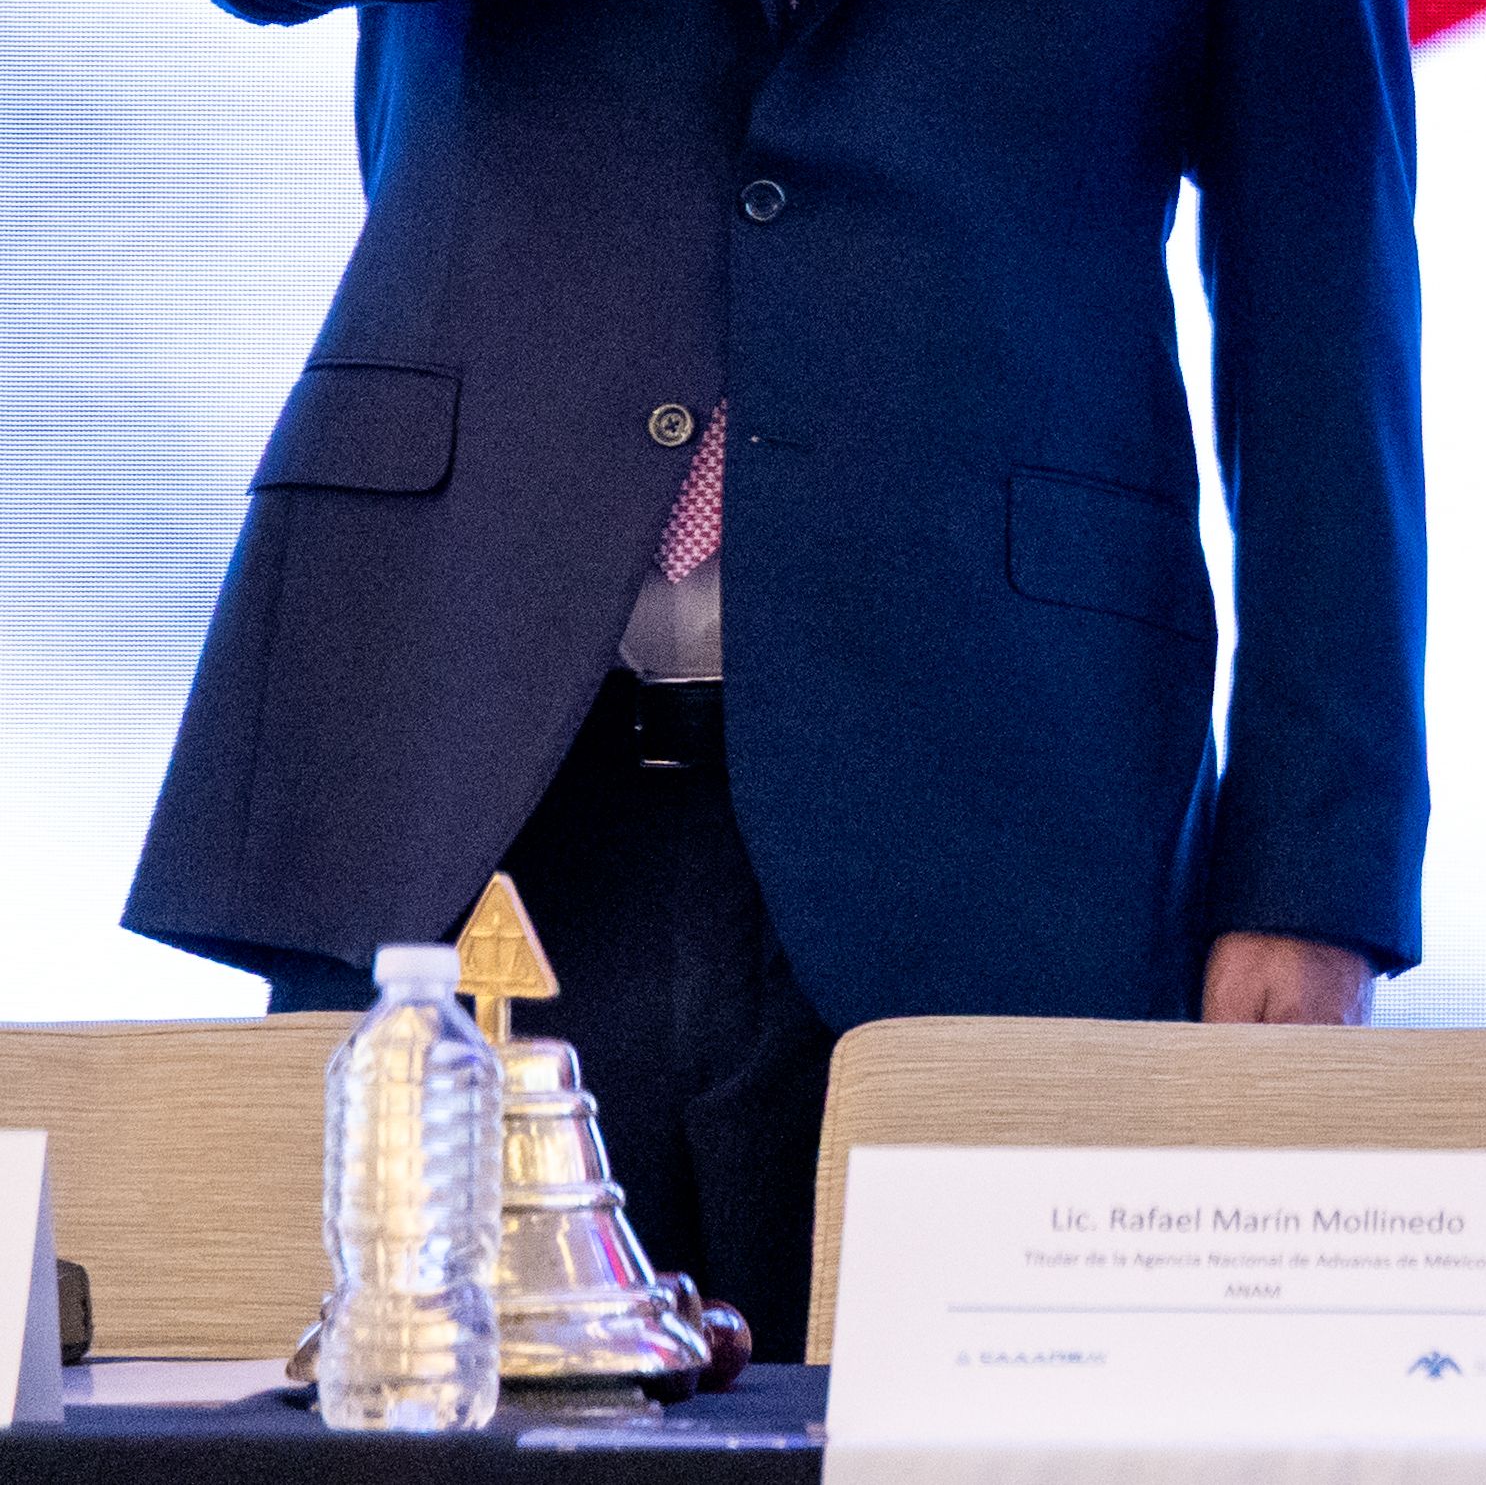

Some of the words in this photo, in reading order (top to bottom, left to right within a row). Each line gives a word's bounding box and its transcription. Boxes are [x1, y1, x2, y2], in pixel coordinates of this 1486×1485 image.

[1050, 1205, 1097, 1233] Lic.
[1108, 1204, 1202, 1233] Rafael
[1211, 1205, 1302, 1233] Marín
[1311, 1206, 1466, 1235] Mollinedo
[1023, 1249, 1080, 1267] Titular
[1084, 1251, 1107, 1267] de
[1111, 1251, 1128, 1267] la
[1132, 1251, 1202, 1270] Agencia
[1206, 1252, 1283, 1268] Nacional
[1287, 1252, 1310, 1268] de
[1315, 1252, 1392, 1269] Aduanas
[1395, 1253, 1418, 1269] de
[1422, 1252, 1486, 1269] México
[1223, 1282, 1283, 1299] ANAM
